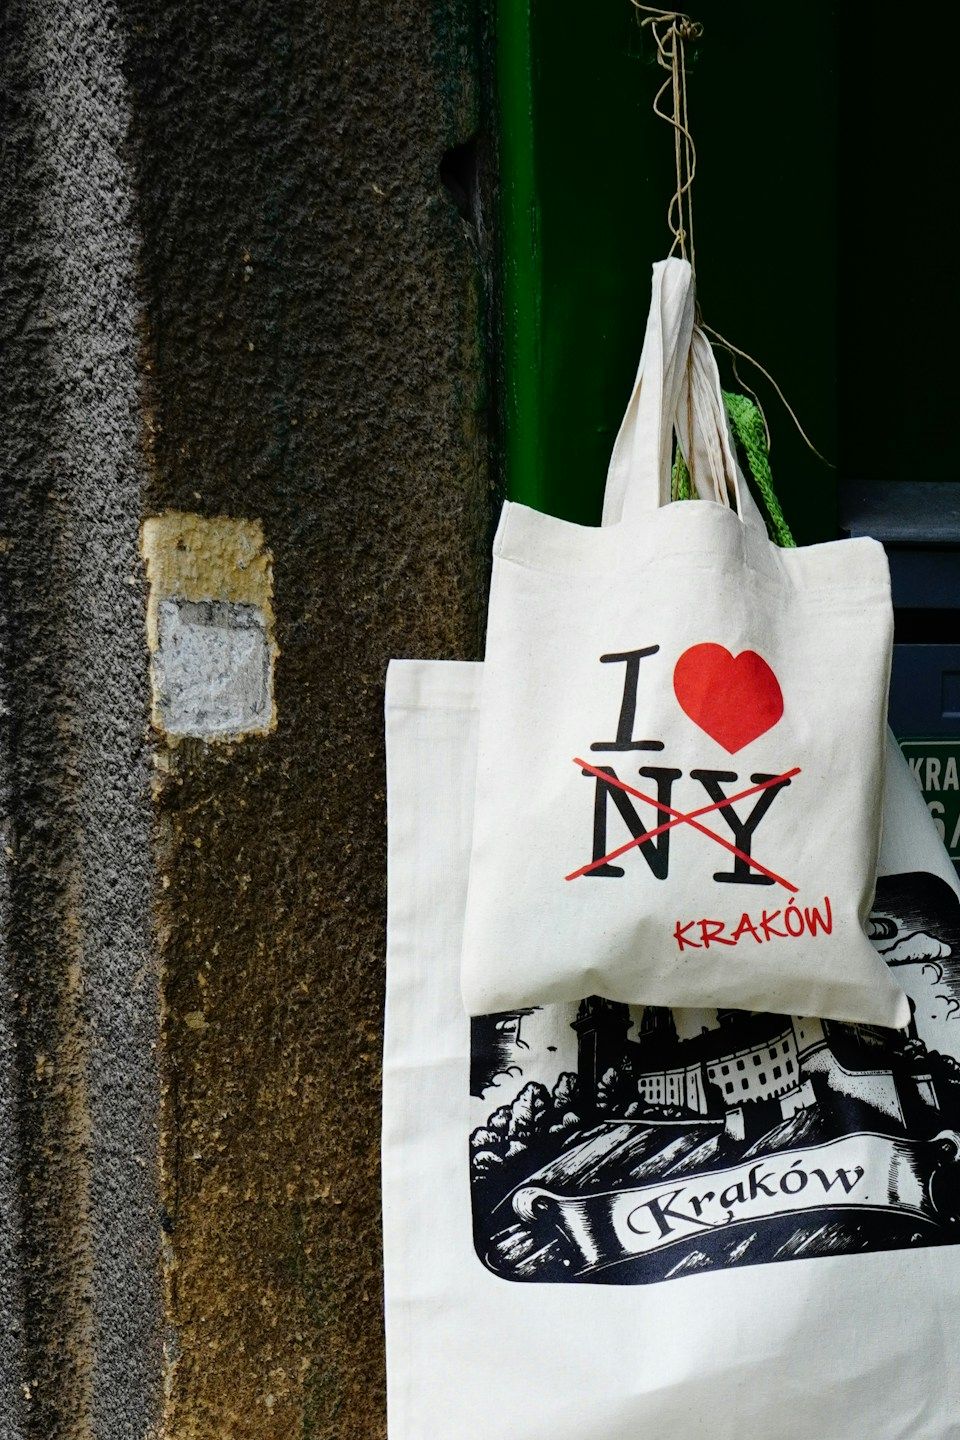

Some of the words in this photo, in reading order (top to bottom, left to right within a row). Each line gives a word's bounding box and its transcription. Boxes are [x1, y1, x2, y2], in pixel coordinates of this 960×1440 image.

[590, 644, 665, 752] I
[581, 766, 792, 886] NY
[673, 896, 833, 951] KRAKÓW
[626, 1159, 865, 1240] Kraków
